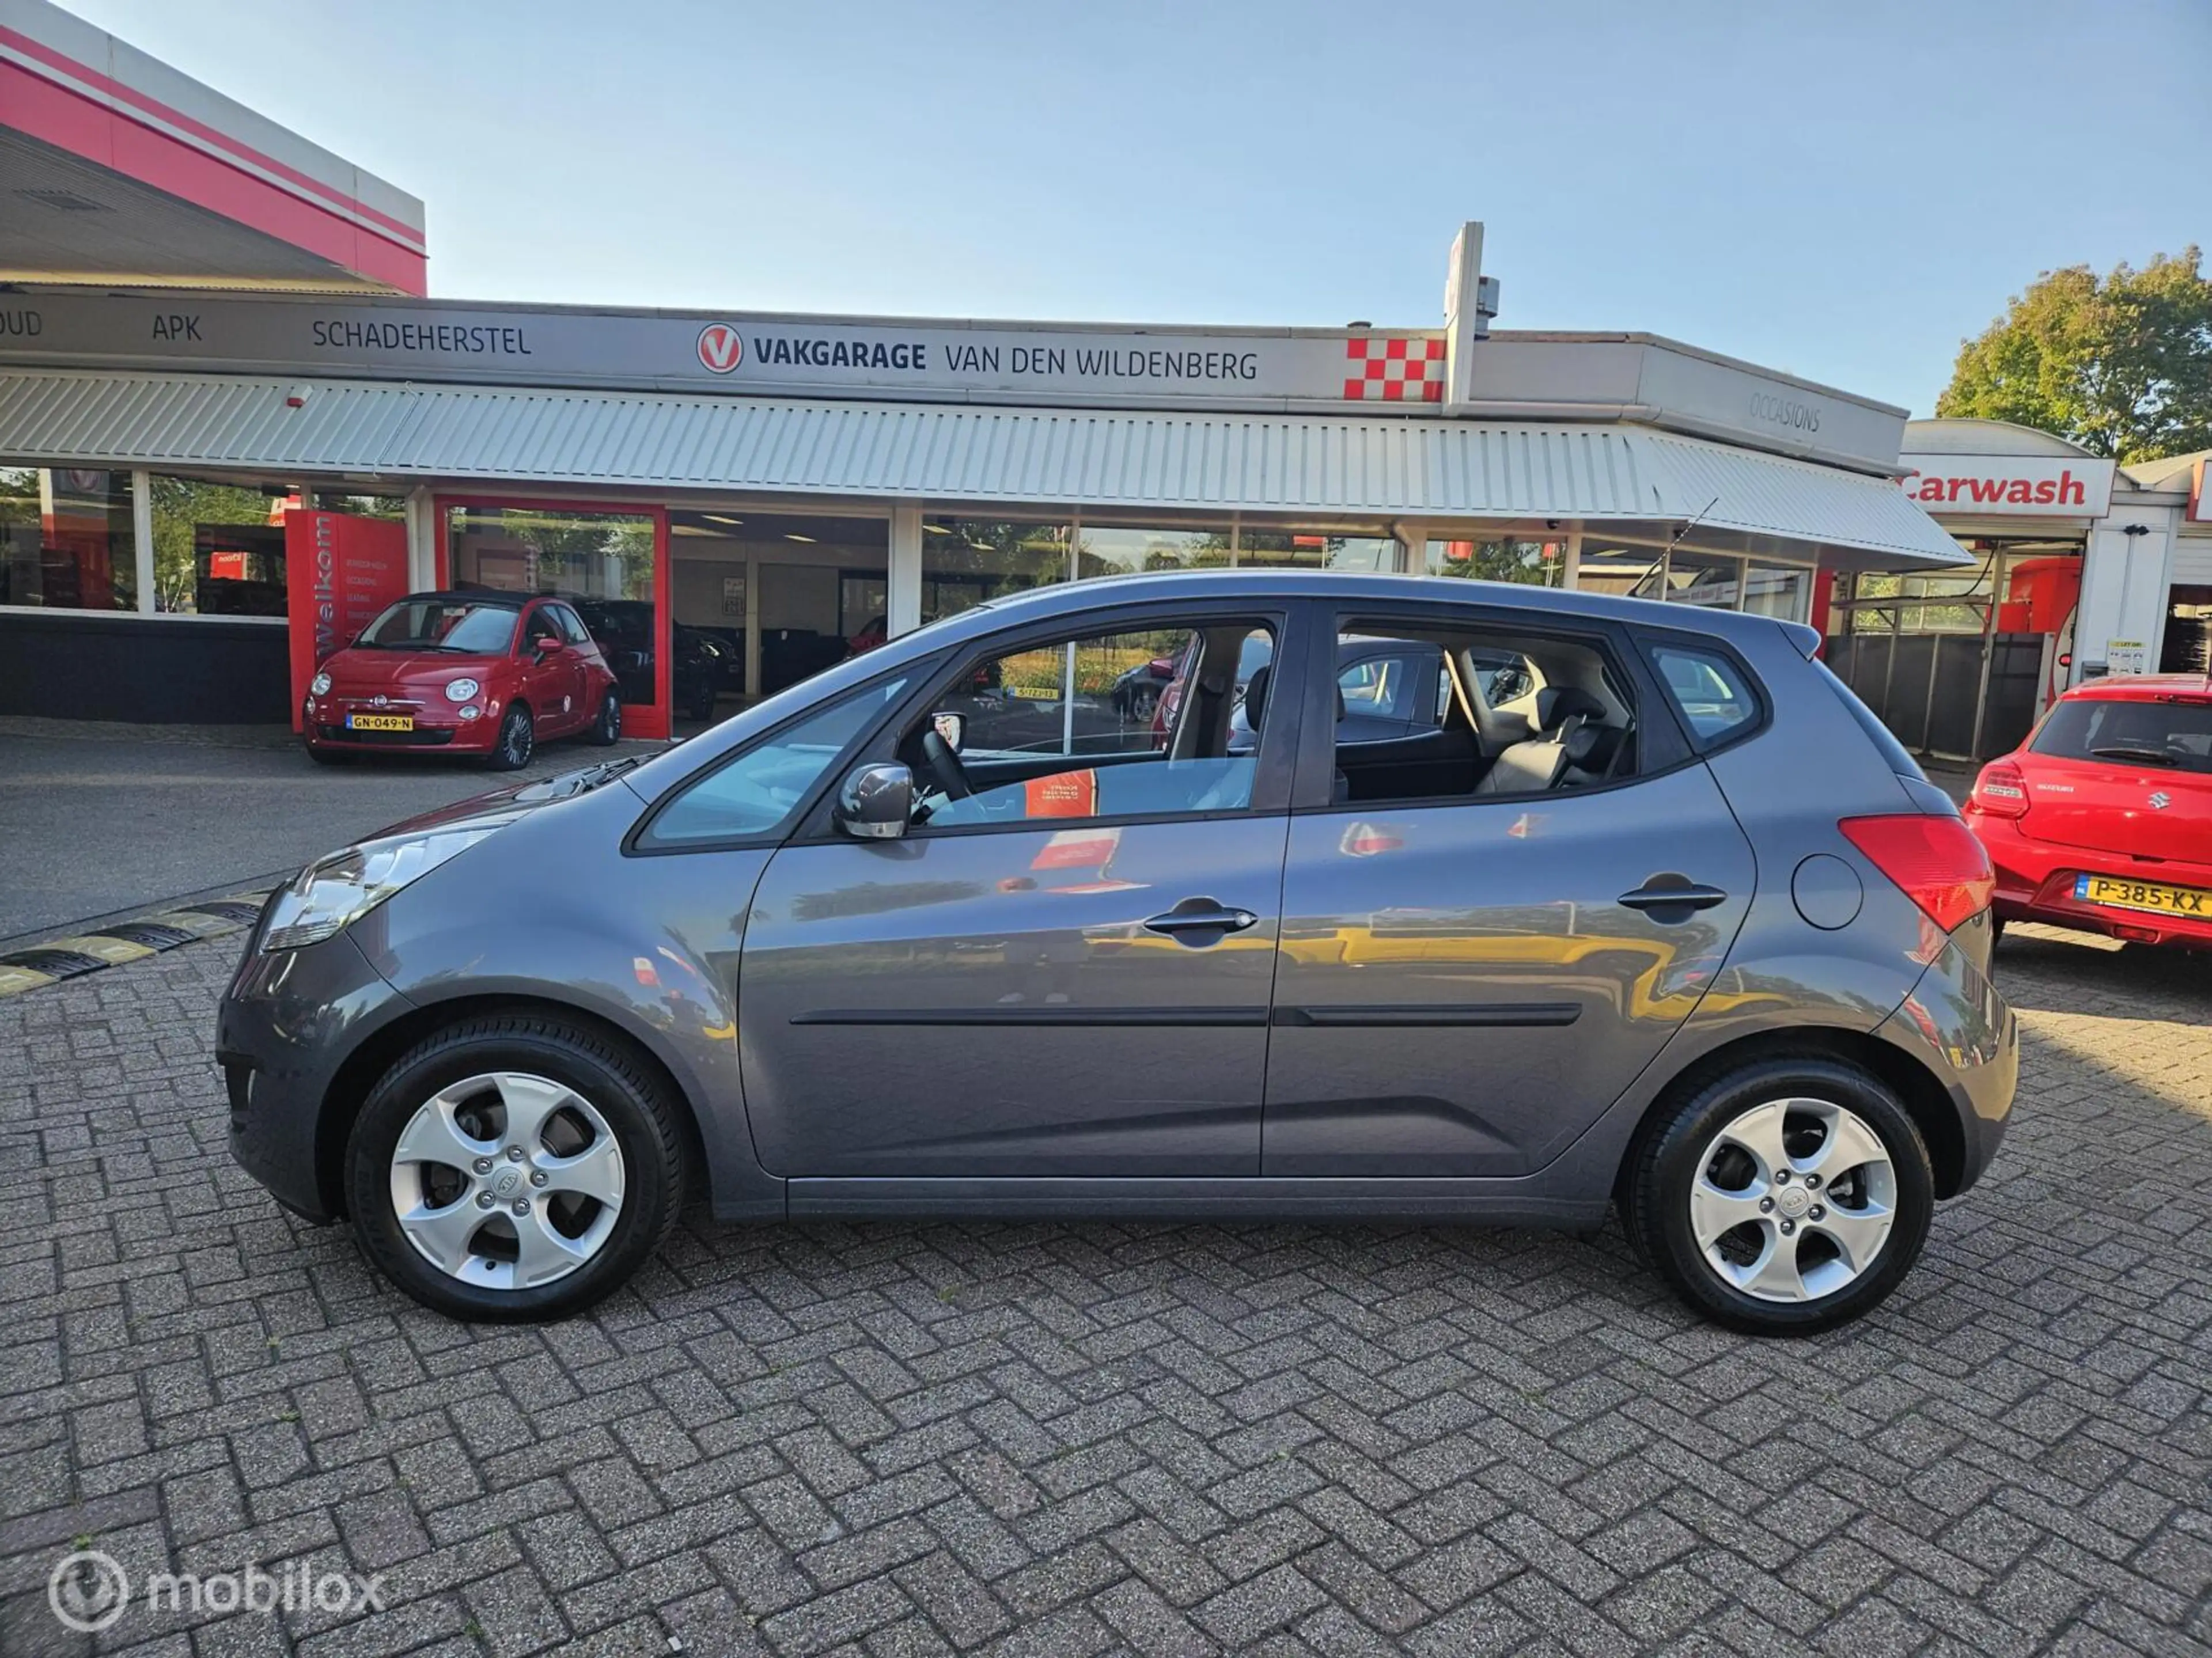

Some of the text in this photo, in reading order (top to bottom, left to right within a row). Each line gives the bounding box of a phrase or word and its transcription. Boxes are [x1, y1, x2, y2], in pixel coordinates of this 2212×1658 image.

[153, 314, 202, 342] APK
[312, 321, 532, 355] SCHADEHERSTEL
[753, 337, 1258, 380] VAKGARAGE VAN DEN WILDENBERG
[1749, 392, 1821, 432] OCCASIONS
[354, 718, 410, 729] GN-049-N
[2096, 880, 2202, 911] P-385-KX
